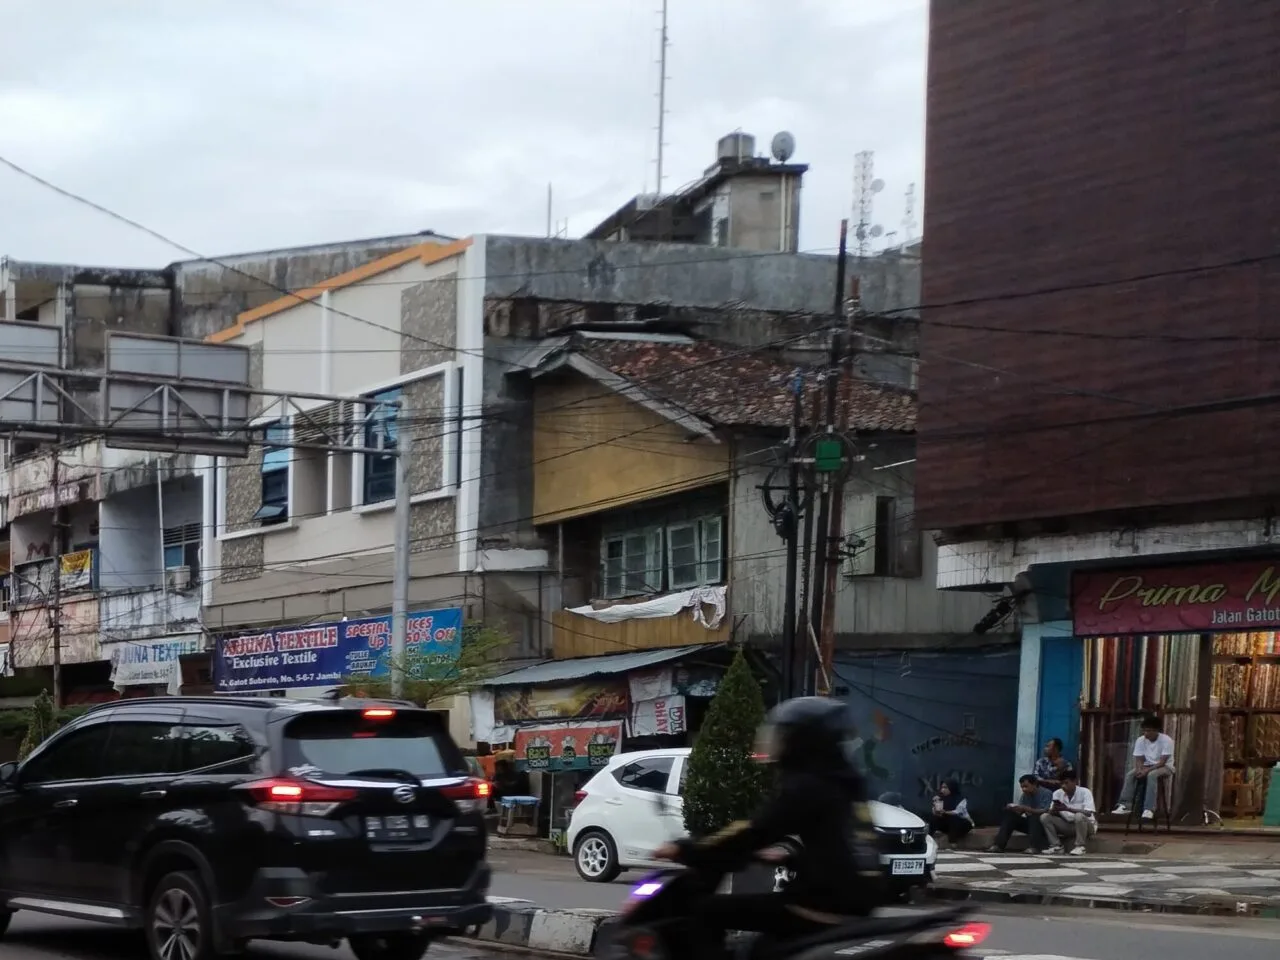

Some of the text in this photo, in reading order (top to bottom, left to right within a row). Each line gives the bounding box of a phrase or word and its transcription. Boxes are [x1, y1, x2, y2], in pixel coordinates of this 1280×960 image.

[1099, 576, 1228, 610] Prima
[1211, 606, 1280, 624] Jalan Gatot
[345, 616, 433, 638] SPESIAL ICES
[276, 626, 338, 651] TEXTILE
[368, 635, 385, 650] Up
[151, 640, 197, 662] TEXTILE
[233, 650, 318, 669] Exclusive Textile
[229, 678, 248, 687] Gatot
[280, 675, 294, 683] No.
[295, 674, 314, 682] 5-6-7
[316, 671, 341, 680] Jambi
